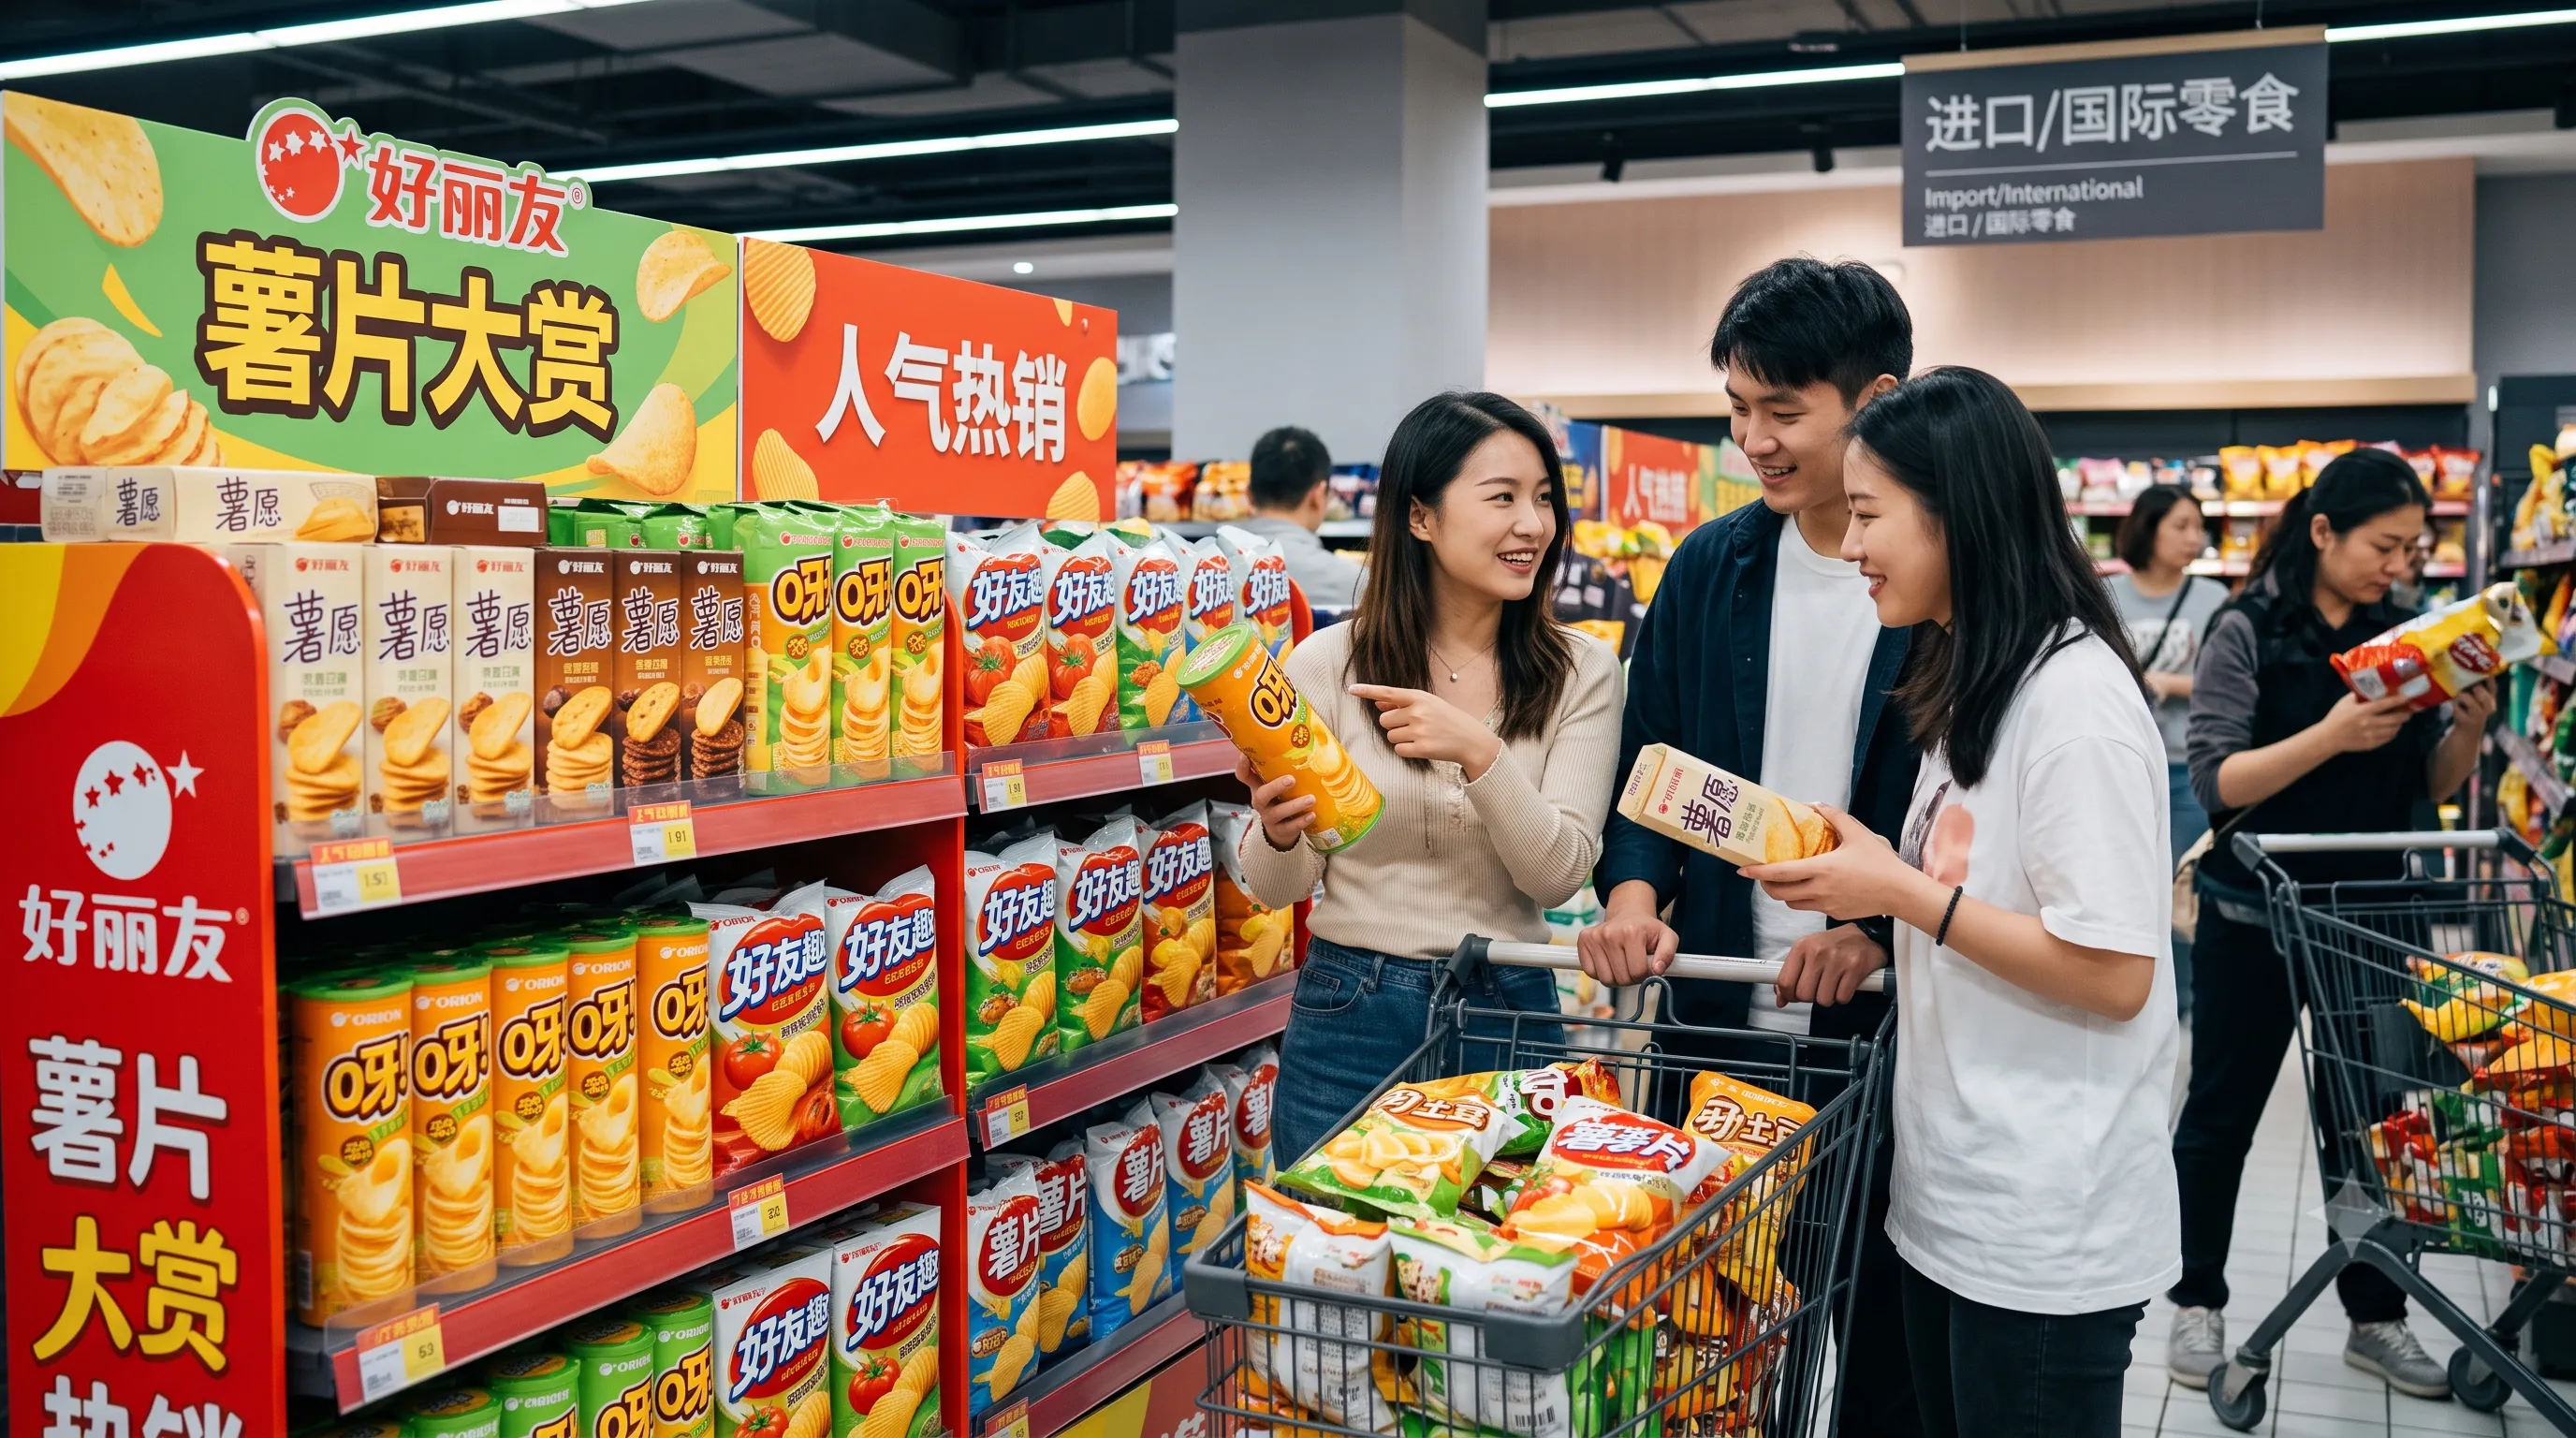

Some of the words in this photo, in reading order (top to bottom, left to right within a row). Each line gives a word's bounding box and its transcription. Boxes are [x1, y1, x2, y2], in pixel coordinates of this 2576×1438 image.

[1925, 72, 2299, 153] 进口/国际零食
[1925, 175, 2144, 211] Import/International
[202, 235, 616, 437] 薯片大赏
[815, 323, 1067, 462] 人气热销
[116, 477, 160, 526] 薯愿
[215, 477, 282, 533] 薯愿
[284, 590, 360, 663] 薯愿
[379, 590, 449, 660] 薯愿
[466, 590, 532, 658] 薯愿
[549, 587, 611, 655] 薯愿
[622, 587, 680, 653] 薯愿
[690, 586, 743, 650] 薯愿
[19, 885, 233, 983] 好丽友
[591, 960, 632, 975] ORION
[839, 909, 934, 992] 好友趣
[436, 991, 482, 1008] ORION
[719, 930, 827, 1022] 好友趣
[352, 1008, 402, 1026] ORION
[28, 1034, 227, 1199] 薯片
[1187, 1105, 1230, 1165] 薯片
[1035, 1167, 1086, 1235] 薯片
[1123, 1137, 1164, 1202] 薯片
[988, 1207, 1040, 1280] 薯片
[33, 1216, 237, 1372] 大赏
